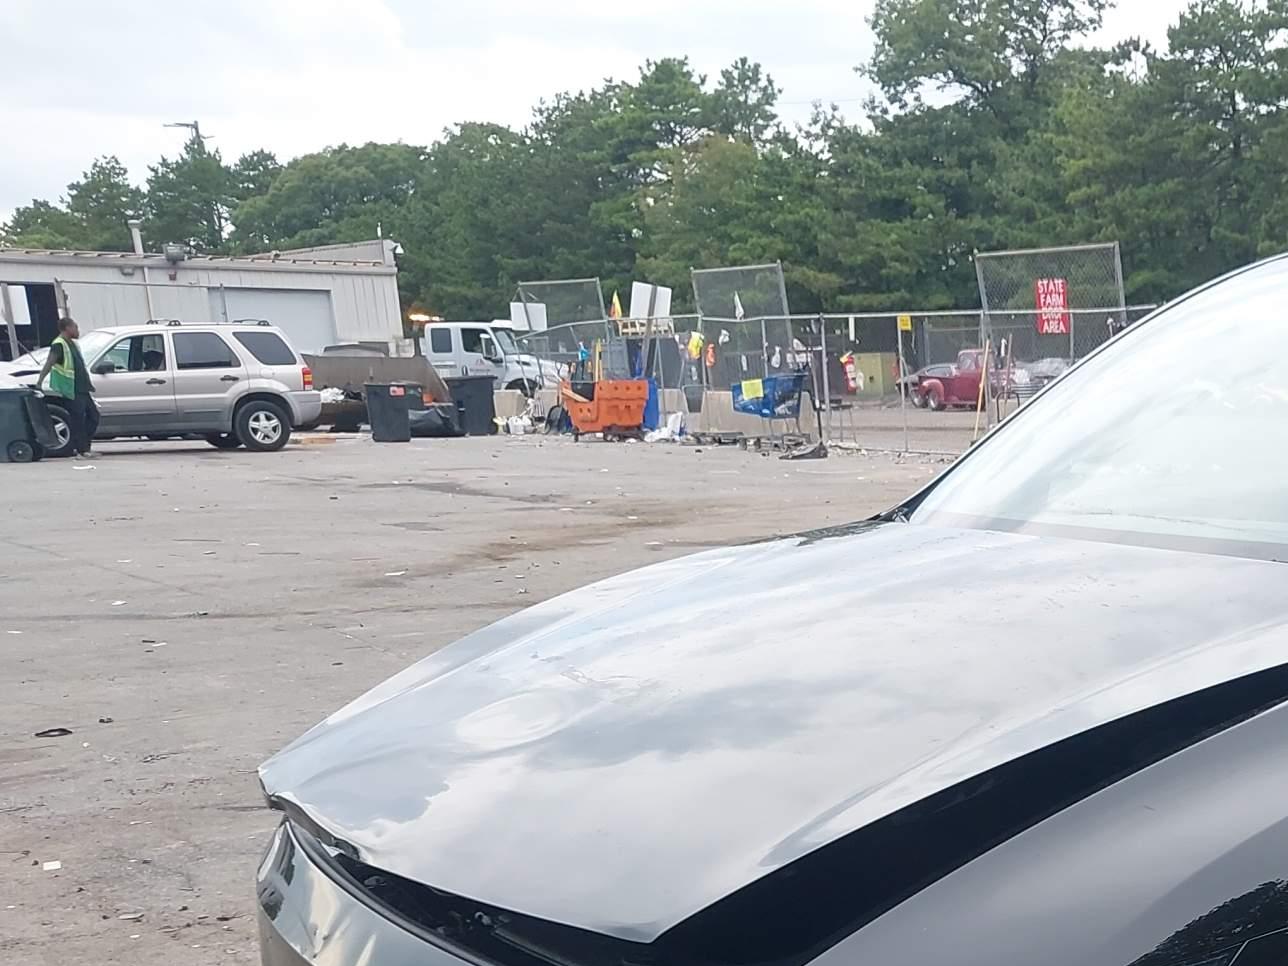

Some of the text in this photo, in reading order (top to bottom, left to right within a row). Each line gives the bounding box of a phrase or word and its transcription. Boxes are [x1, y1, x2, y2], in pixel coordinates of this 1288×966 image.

[1038, 278, 1064, 293] STATE
[1040, 293, 1065, 307] FARM
[1043, 319, 1067, 334] AREA
